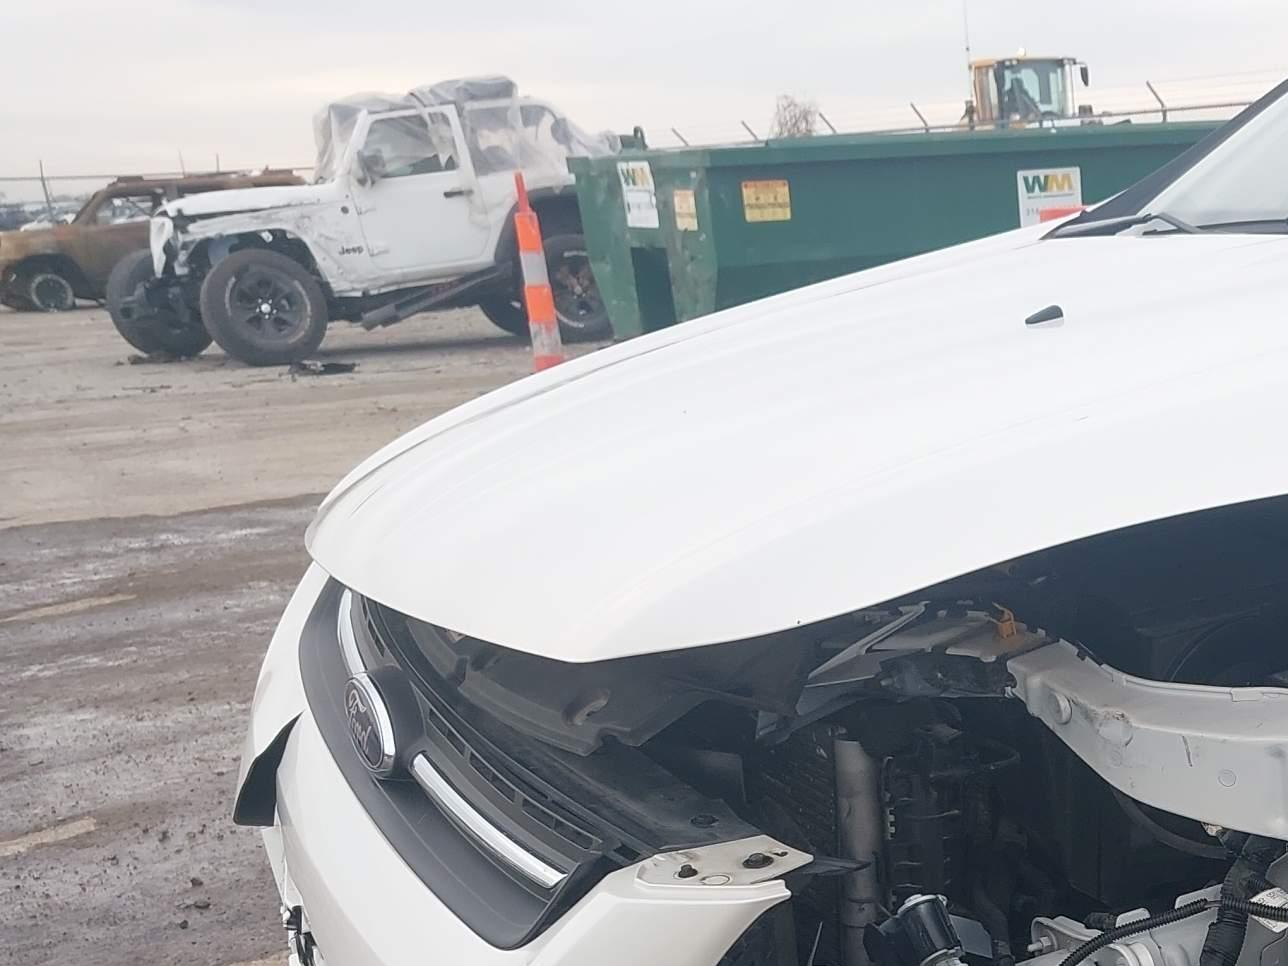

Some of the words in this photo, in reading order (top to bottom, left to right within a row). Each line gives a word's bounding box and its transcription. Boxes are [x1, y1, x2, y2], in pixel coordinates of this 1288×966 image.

[620, 167, 650, 186] WM
[1022, 174, 1073, 194] WM
[338, 245, 364, 256] Jeep
[346, 688, 372, 757] Ford
